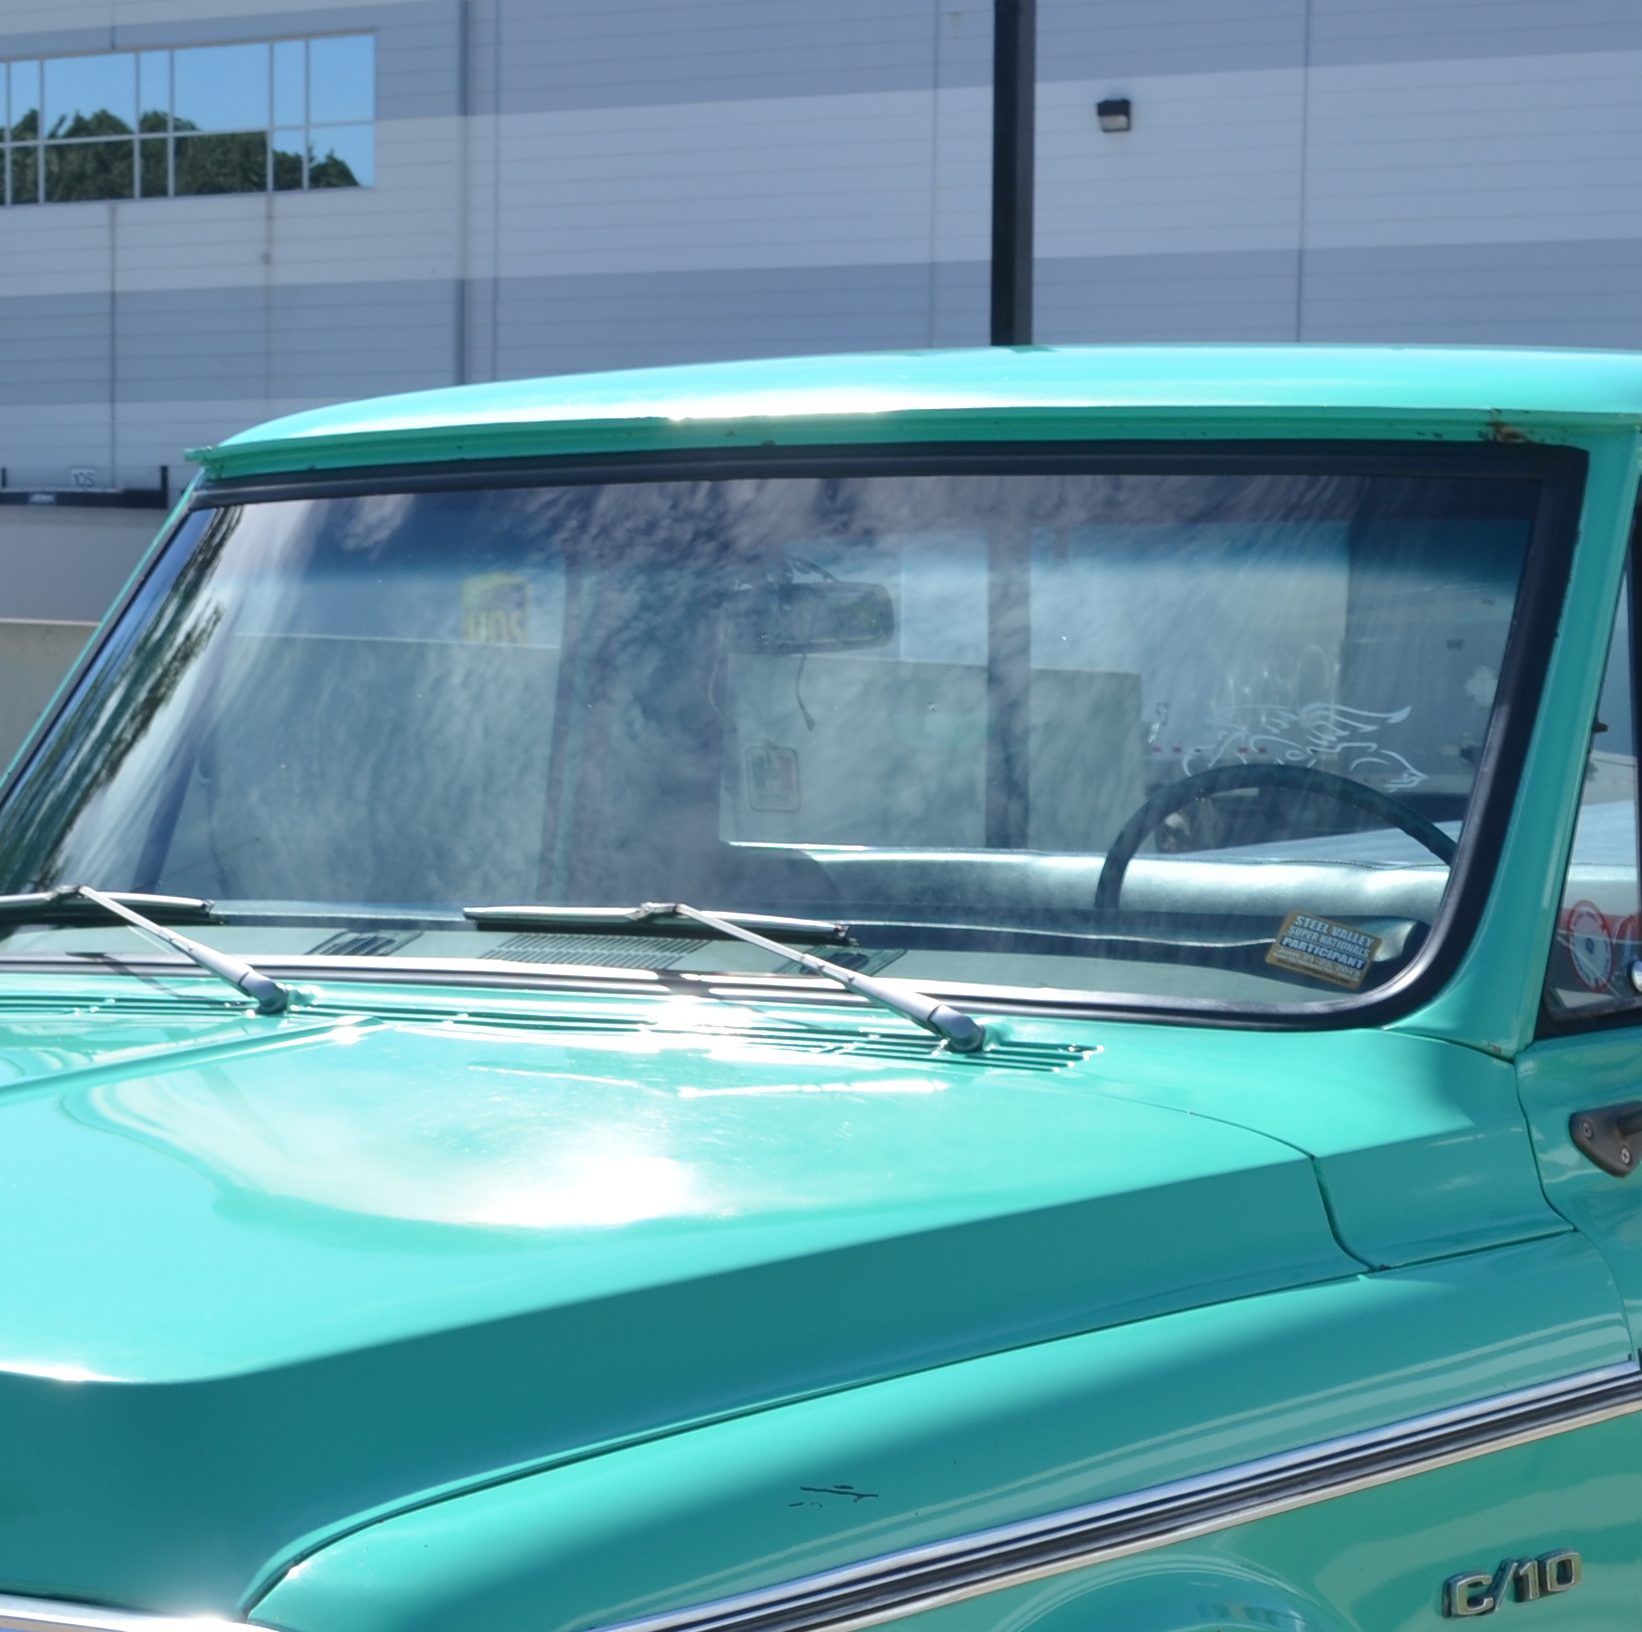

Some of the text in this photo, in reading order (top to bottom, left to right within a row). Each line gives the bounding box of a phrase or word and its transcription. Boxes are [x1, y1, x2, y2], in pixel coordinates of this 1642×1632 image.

[1288, 925, 1371, 958] SUPER NATIONALS
[1294, 915, 1375, 947] STEEL VALLEY
[1282, 936, 1366, 969] PARTICIPANT
[1442, 1549, 1583, 1619] C/10
